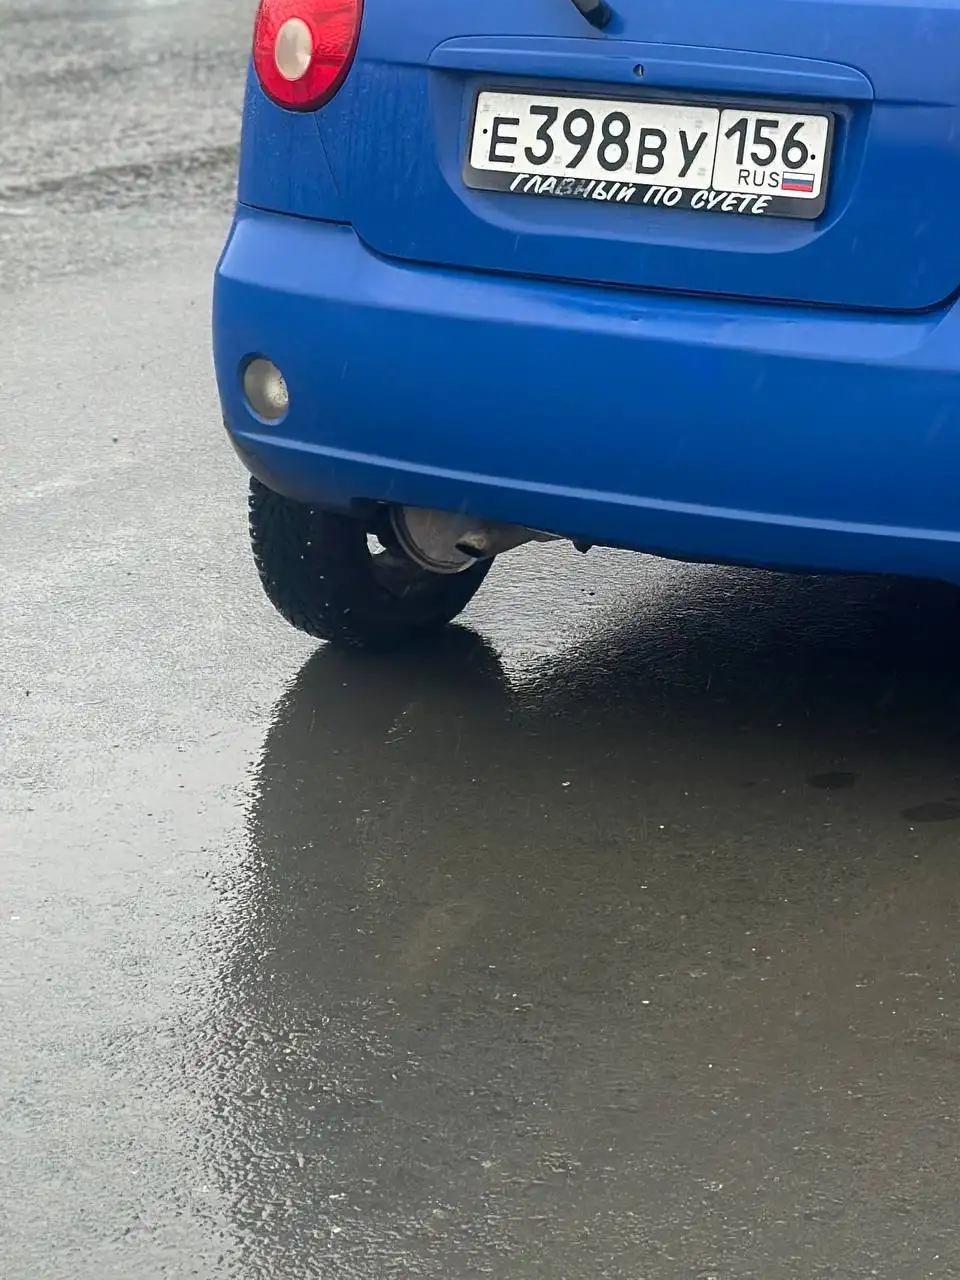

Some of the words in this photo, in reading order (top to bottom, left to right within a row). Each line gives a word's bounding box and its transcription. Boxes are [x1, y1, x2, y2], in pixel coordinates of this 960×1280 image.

[487, 105, 708, 178] Е398ВУ
[724, 117, 809, 169] 156
[738, 169, 780, 188] RUS
[642, 185, 683, 207] ПО
[690, 190, 773, 214] СУЕТЕ
